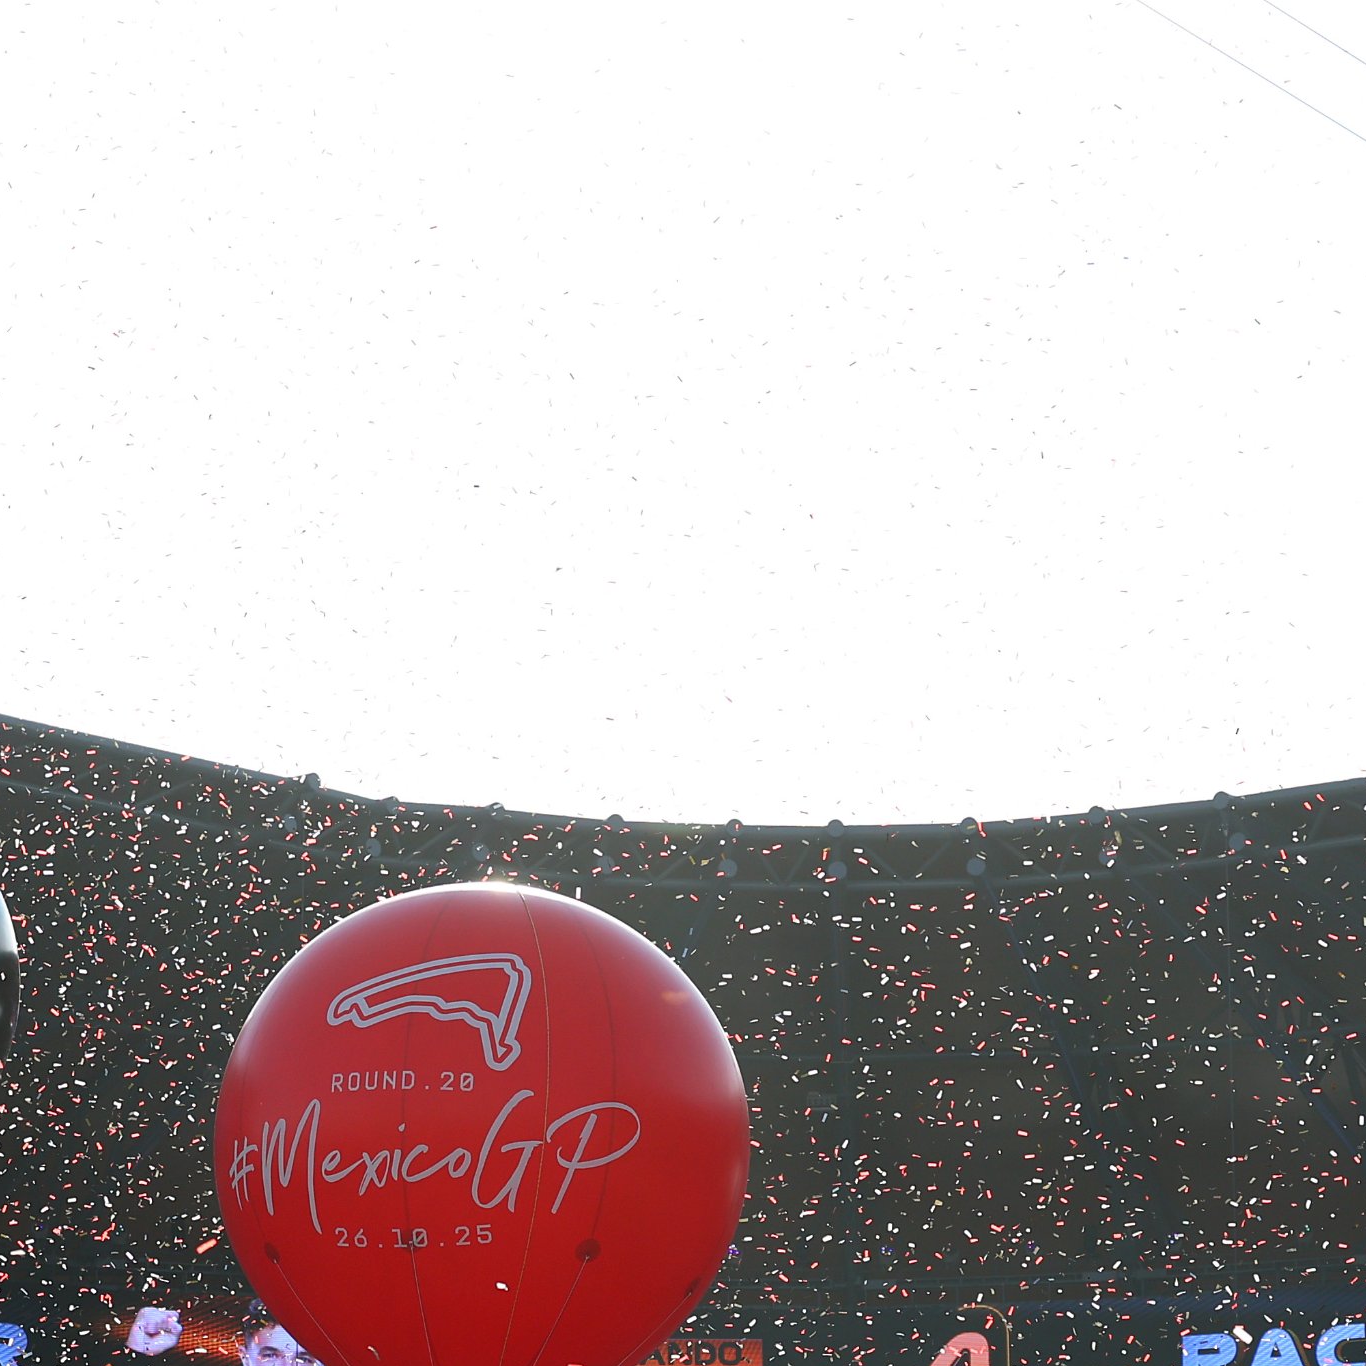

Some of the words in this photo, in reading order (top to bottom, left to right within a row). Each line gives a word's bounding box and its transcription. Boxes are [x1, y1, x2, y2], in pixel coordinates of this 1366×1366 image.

[230, 1089, 641, 1234] #MexicoGP
[334, 1223, 493, 1249] 26.10.25
[640, 1342, 744, 1366] ANDO
